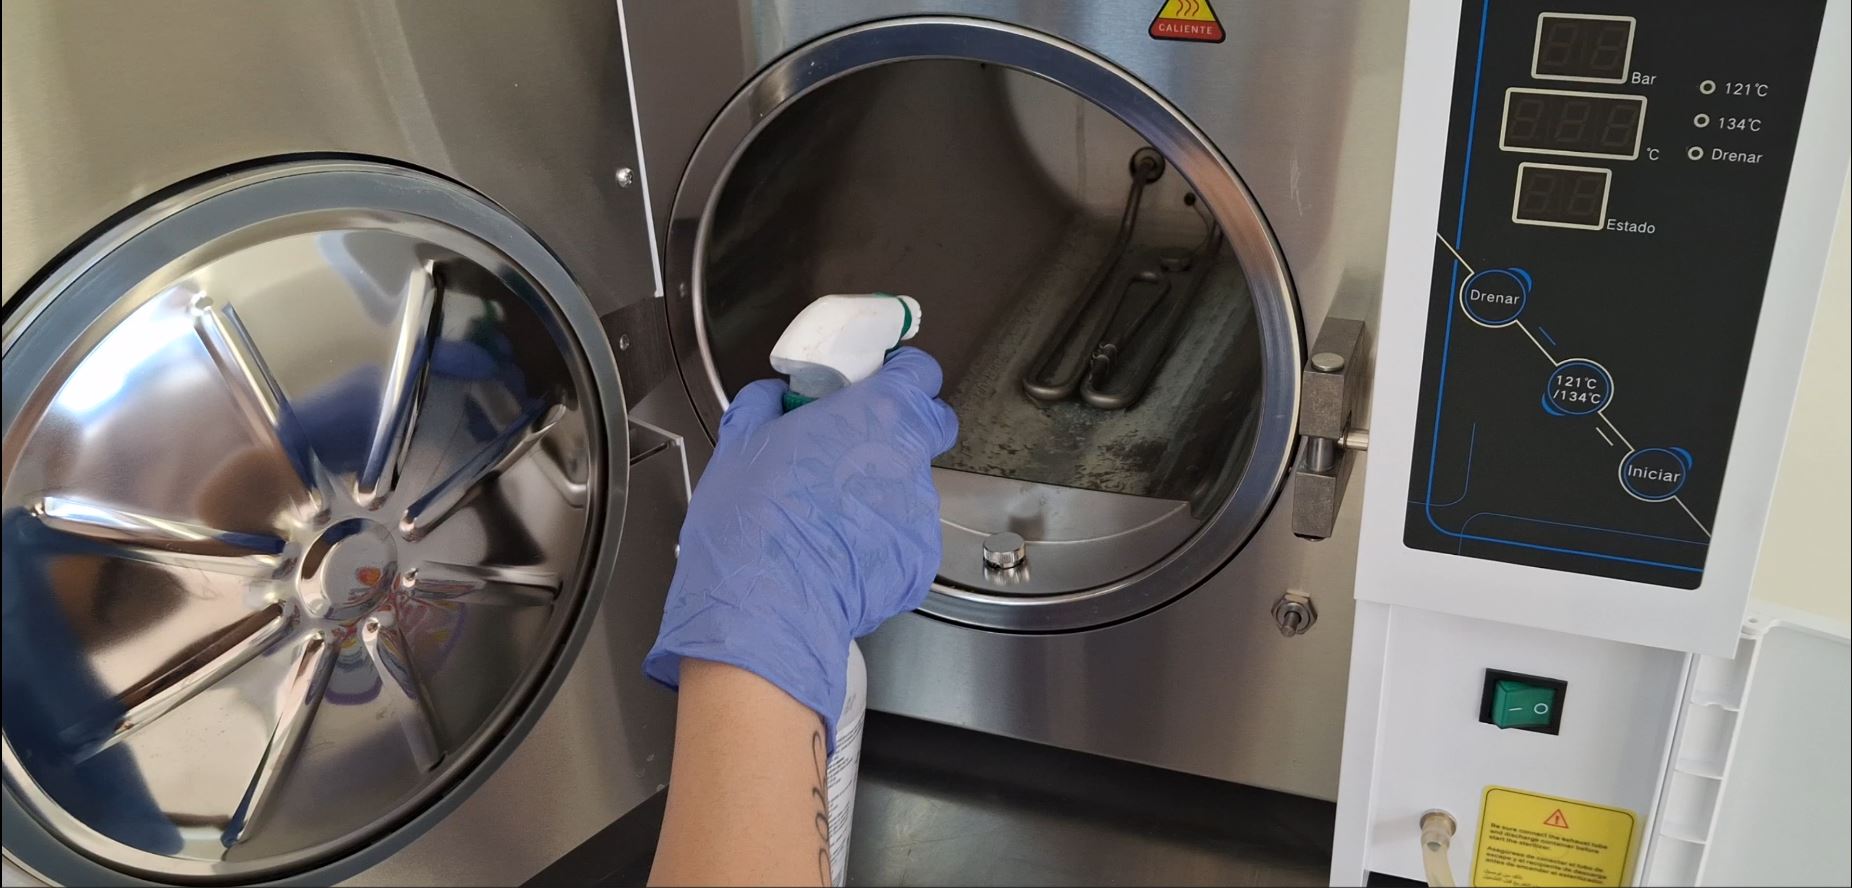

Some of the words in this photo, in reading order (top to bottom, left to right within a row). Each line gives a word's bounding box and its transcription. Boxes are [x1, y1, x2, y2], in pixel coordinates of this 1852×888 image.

[1158, 23, 1213, 35] CALIENTE
[1631, 72, 1656, 85] Bar
[1711, 148, 1763, 163] Drenar
[1606, 219, 1656, 234] Estado
[1470, 289, 1520, 305] Drenar
[1627, 464, 1681, 483] Iniciar
